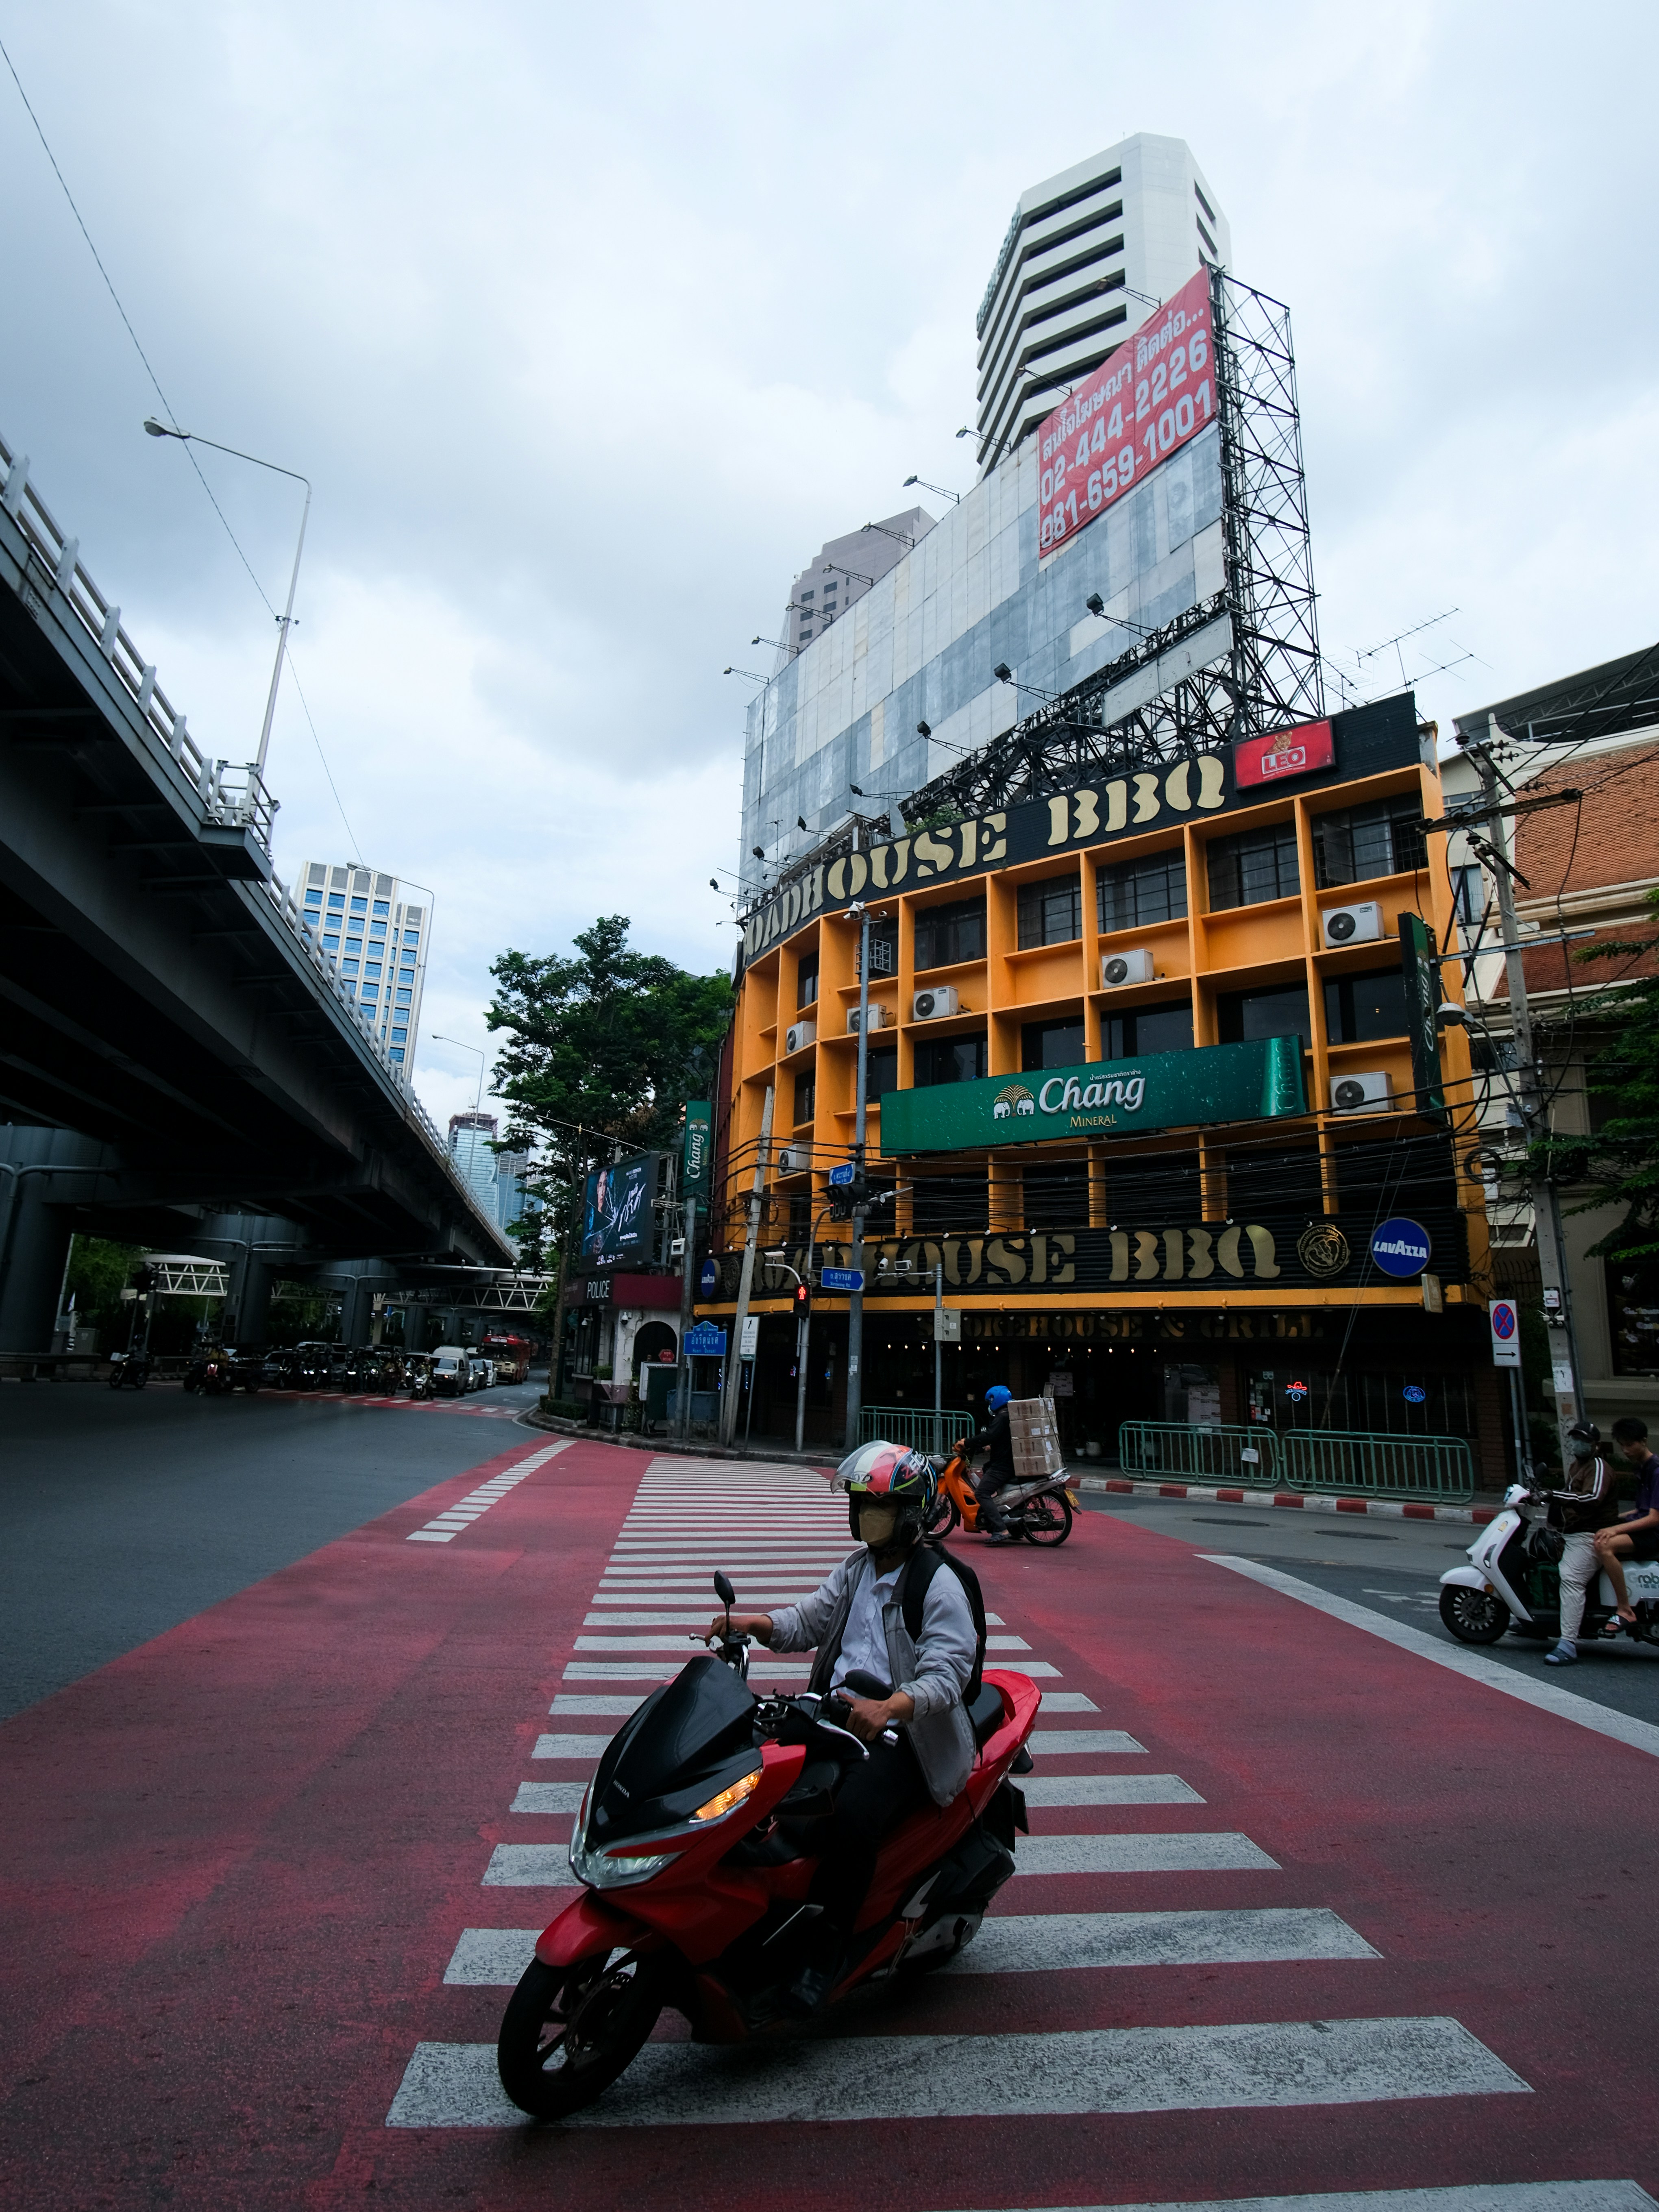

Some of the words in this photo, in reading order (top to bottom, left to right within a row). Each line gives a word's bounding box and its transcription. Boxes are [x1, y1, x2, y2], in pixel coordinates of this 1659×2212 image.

[1041, 329, 1208, 506] 02-444-2226
[1042, 362, 1132, 462] สนใจโฆษณา
[1040, 381, 1211, 549] 081-659-1001
[1264, 749, 1304, 773] LEO
[1047, 755, 1225, 846] BBQ
[1039, 1076, 1146, 1113] Chang
[686, 1133, 705, 1179] Chang
[1109, 1225, 1280, 1281] BBQ
[1373, 1240, 1428, 1258] LAVAZZA
[587, 1280, 610, 1299] POLICE
[917, 1316, 1143, 1337] SOKEHOUSE
[1160, 1315, 1184, 1338] &
[1200, 1314, 1324, 1338] GRILL
[613, 1779, 630, 1799] HONDA
